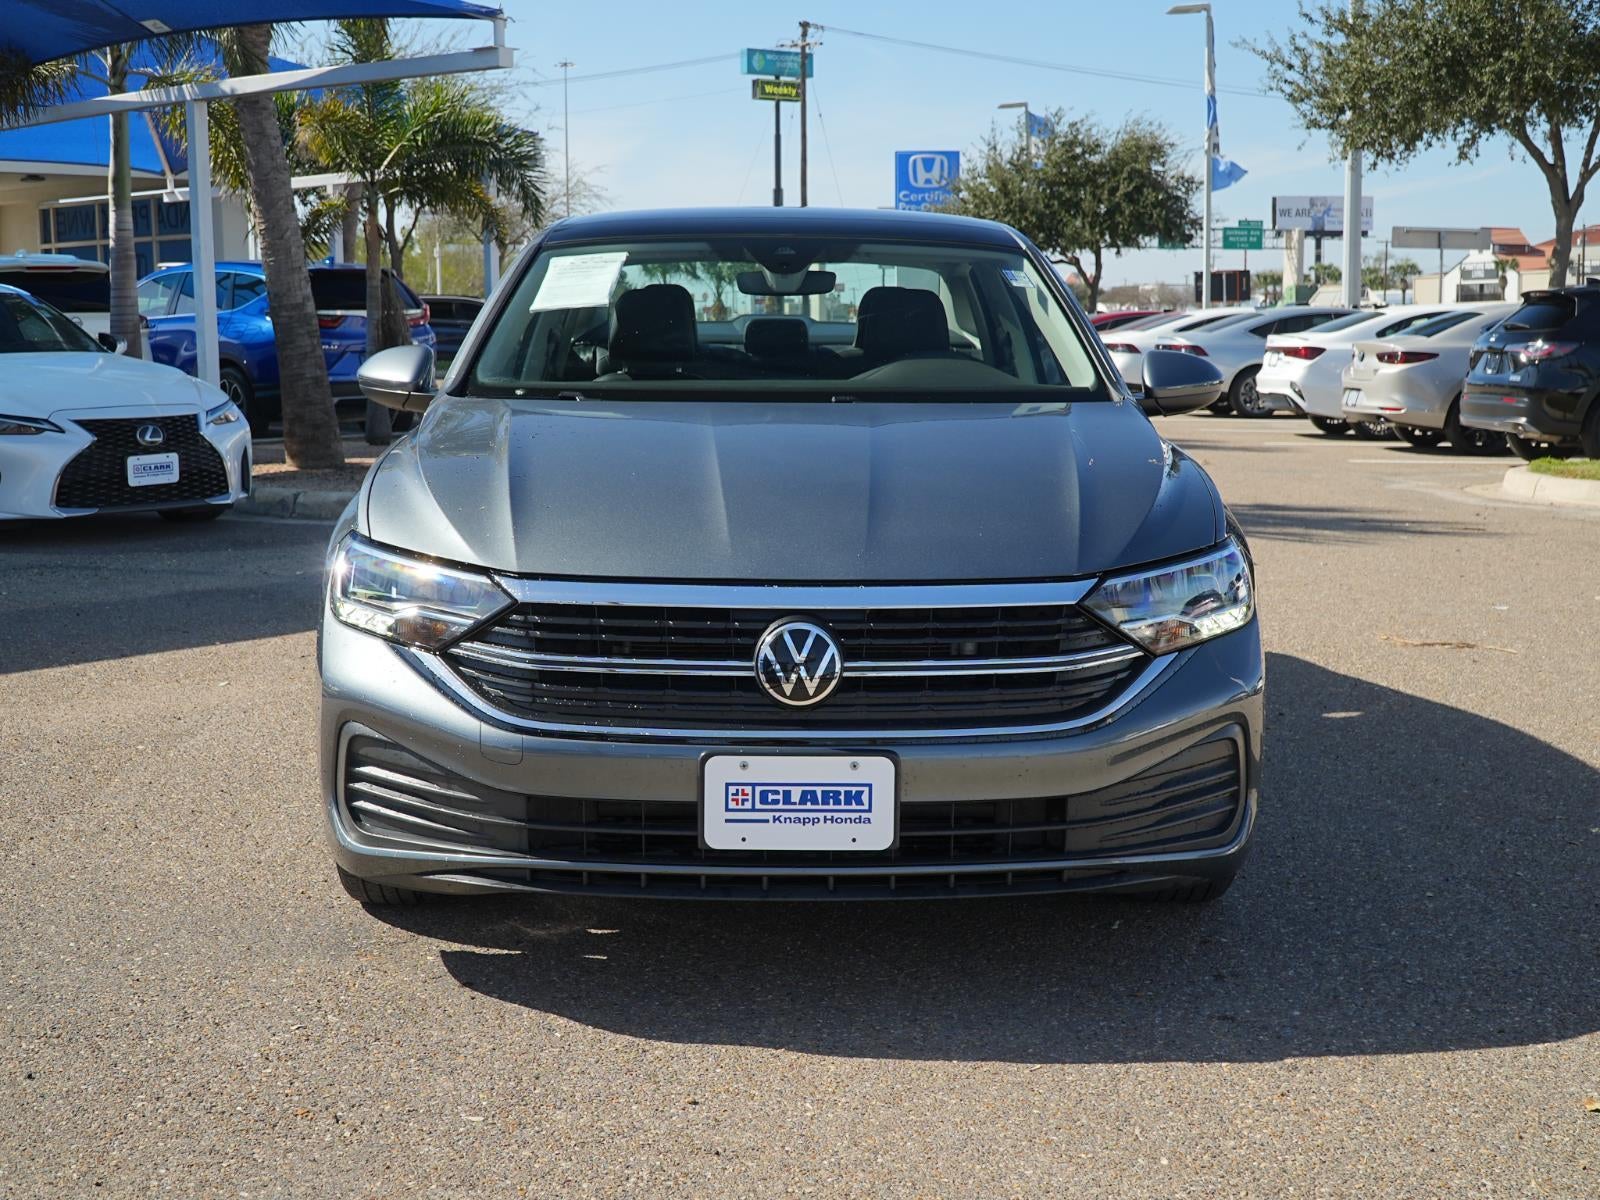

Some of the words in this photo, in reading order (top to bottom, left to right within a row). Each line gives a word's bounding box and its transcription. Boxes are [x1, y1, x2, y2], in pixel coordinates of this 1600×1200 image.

[764, 84, 797, 97] Weekly
[1279, 207, 1293, 217] WE
[1295, 207, 1313, 217] ARE
[142, 464, 171, 472] CLARK
[758, 788, 866, 807] CLARK
[772, 814, 820, 827] Knapp
[823, 814, 872, 825] Honda
